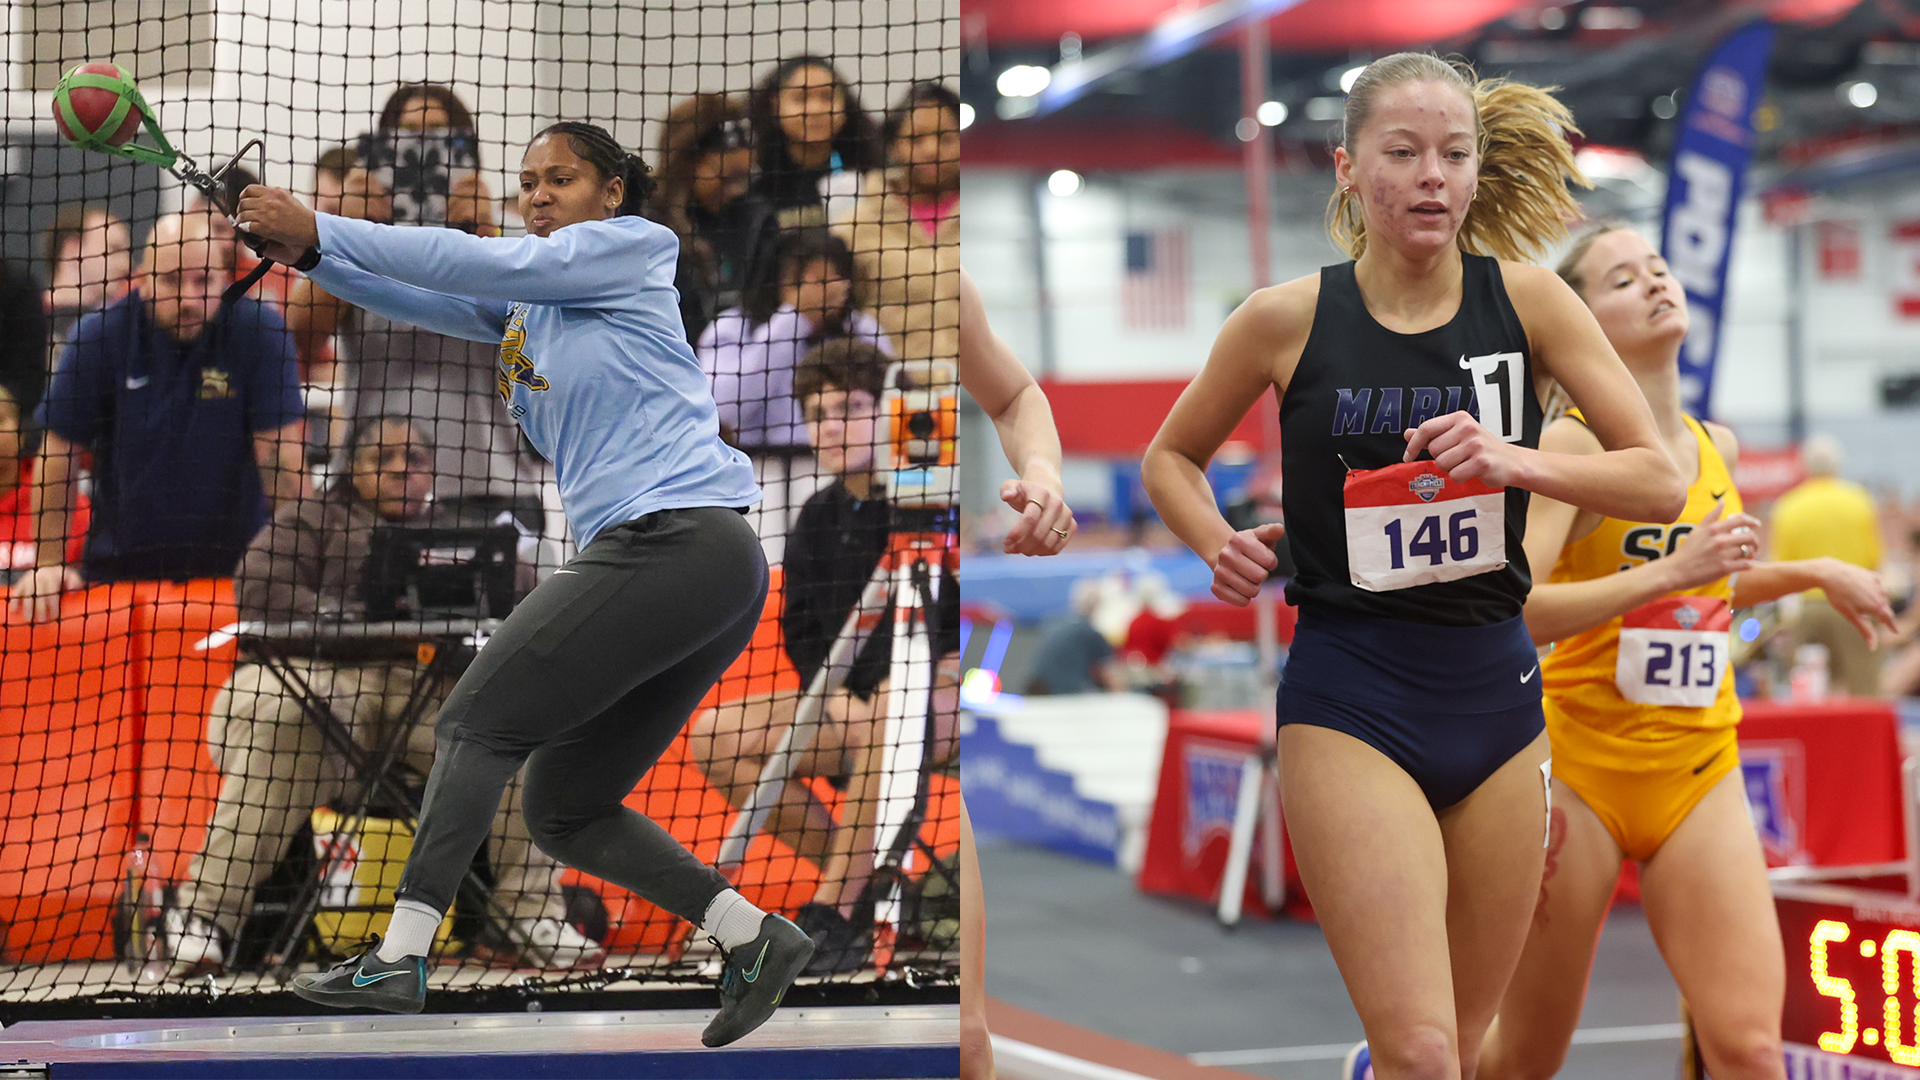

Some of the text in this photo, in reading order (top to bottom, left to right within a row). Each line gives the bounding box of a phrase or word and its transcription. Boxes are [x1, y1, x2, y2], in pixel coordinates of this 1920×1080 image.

[1483, 360, 1512, 437] 1
[1384, 509, 1479, 570] 146
[1645, 642, 1715, 687] 213
[1809, 919, 1920, 1067] 5:0
